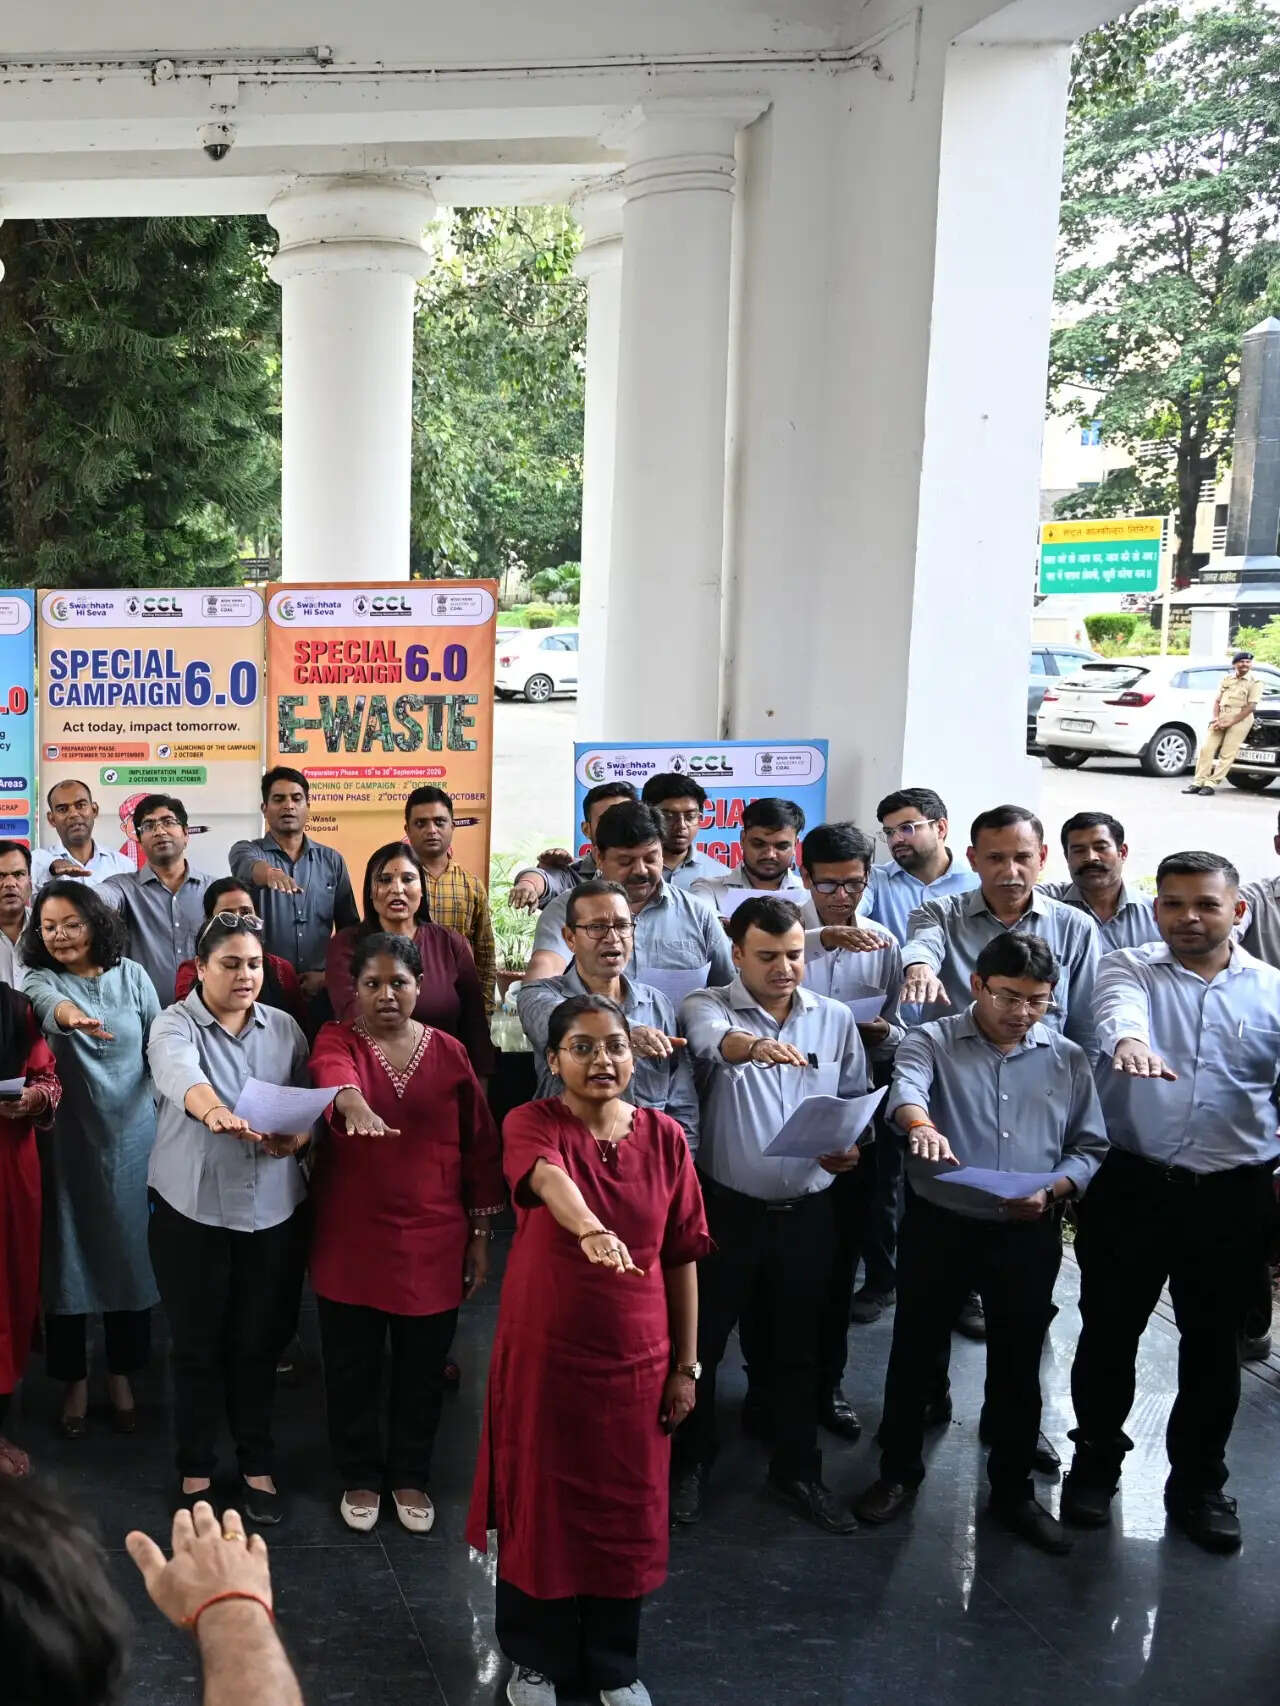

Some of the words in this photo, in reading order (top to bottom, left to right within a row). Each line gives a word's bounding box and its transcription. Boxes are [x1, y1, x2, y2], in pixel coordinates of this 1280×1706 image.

[69, 602, 114, 610] Swachhata
[143, 598, 182, 612] CCL
[297, 601, 341, 609] Swachhata
[372, 596, 412, 611] CCL
[86, 609, 107, 617] Seva
[314, 608, 334, 616] Seva
[293, 640, 402, 664] SPECIAL
[50, 649, 181, 681] SPECIAL
[293, 664, 402, 684] CAMPAIGN
[405, 643, 468, 682] 6.0
[49, 683, 183, 706] CAMPAIGN
[184, 660, 257, 707] 6.0
[63, 721, 86, 733] Act
[88, 720, 126, 735] today,
[130, 721, 172, 734] impact
[176, 721, 240, 733] tomorrow.
[277, 694, 479, 753] E-WASTE
[606, 761, 656, 770] Swachhata
[689, 755, 733, 771] CCL
[304, 769, 339, 777] Preparatory
[393, 769, 426, 777] September
[626, 769, 648, 777] Seva
[344, 782, 353, 790] OF
[355, 781, 396, 790] CAMPAIGN
[346, 793, 371, 801] PHASE
[450, 792, 487, 801] OCTOBER
[305, 824, 339, 832] Disposal
